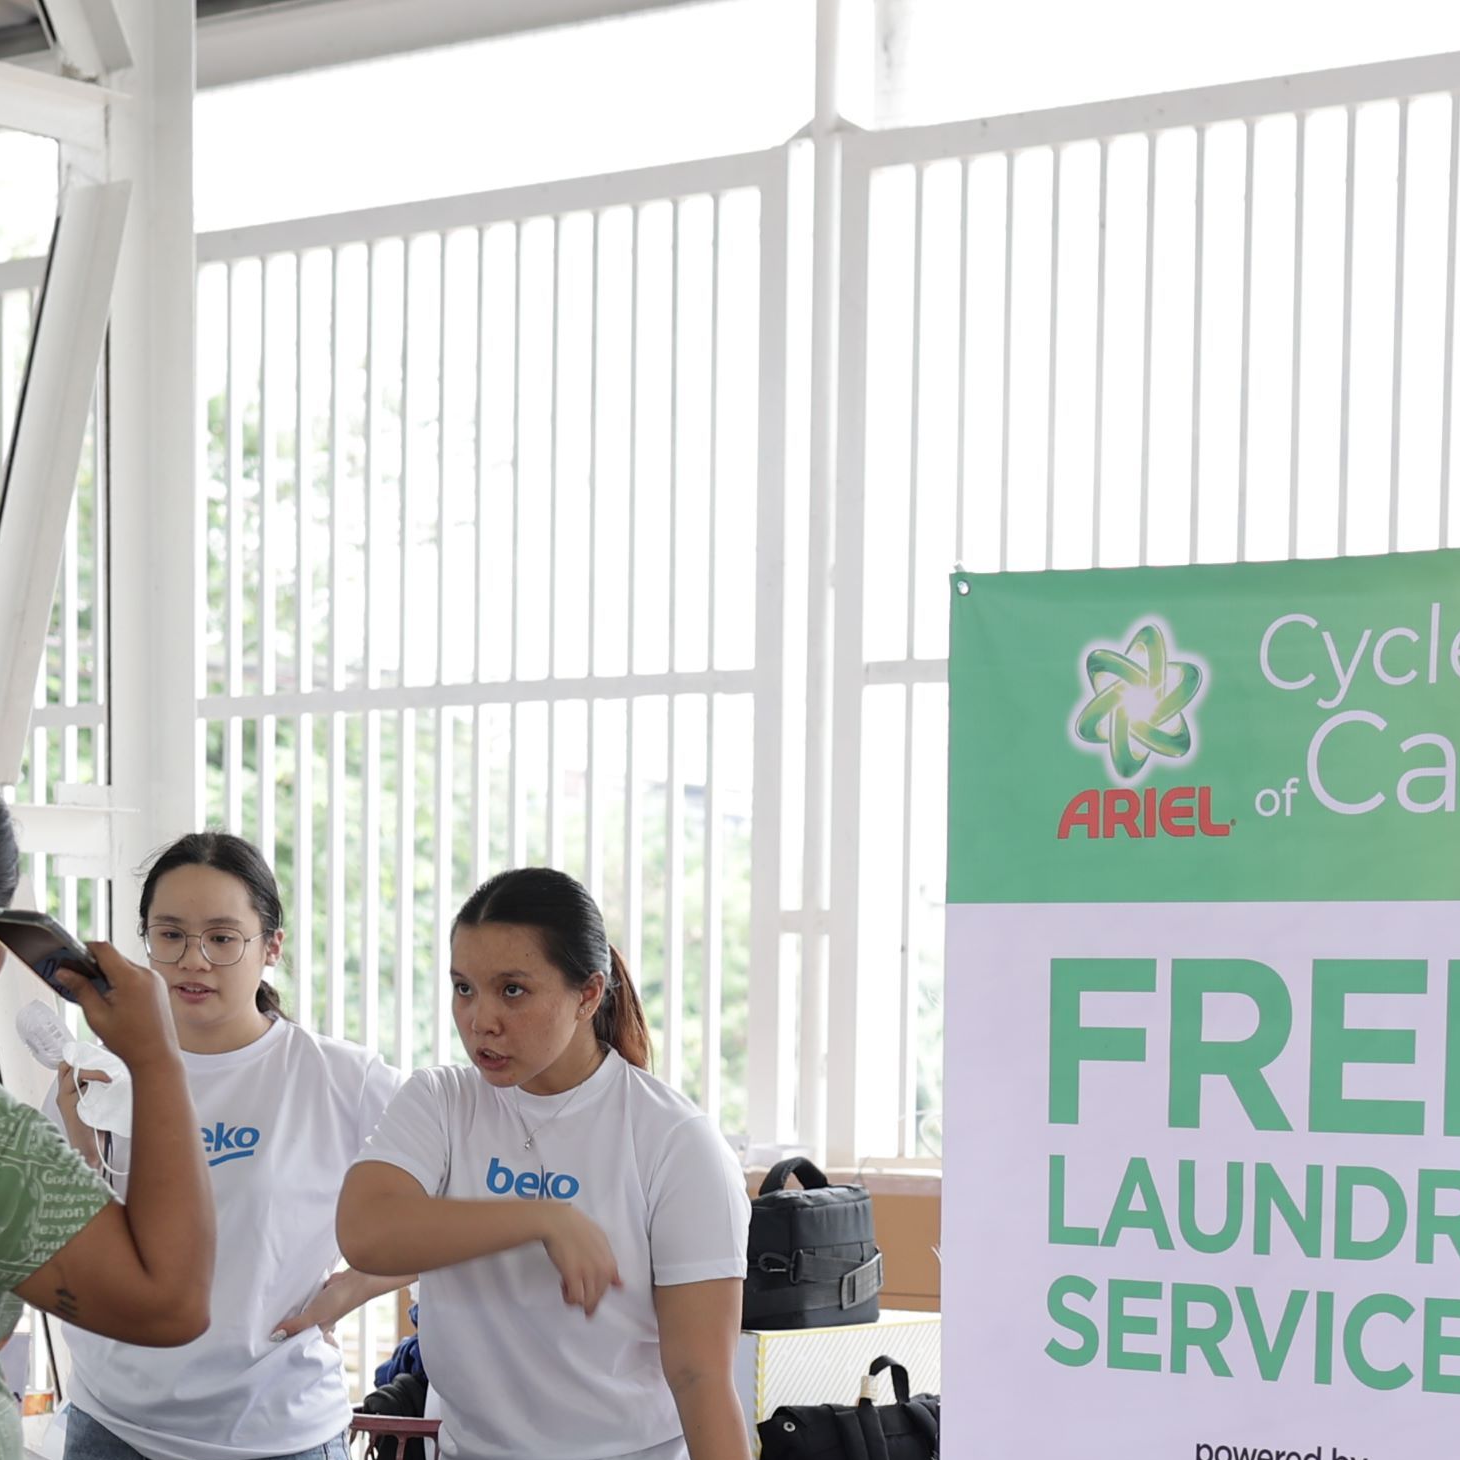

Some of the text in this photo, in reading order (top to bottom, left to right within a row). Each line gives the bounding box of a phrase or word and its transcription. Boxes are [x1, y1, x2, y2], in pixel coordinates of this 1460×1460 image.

[1057, 786, 1231, 839] ARIEL
[1255, 777, 1299, 817] of
[485, 1157, 580, 1200] beko
